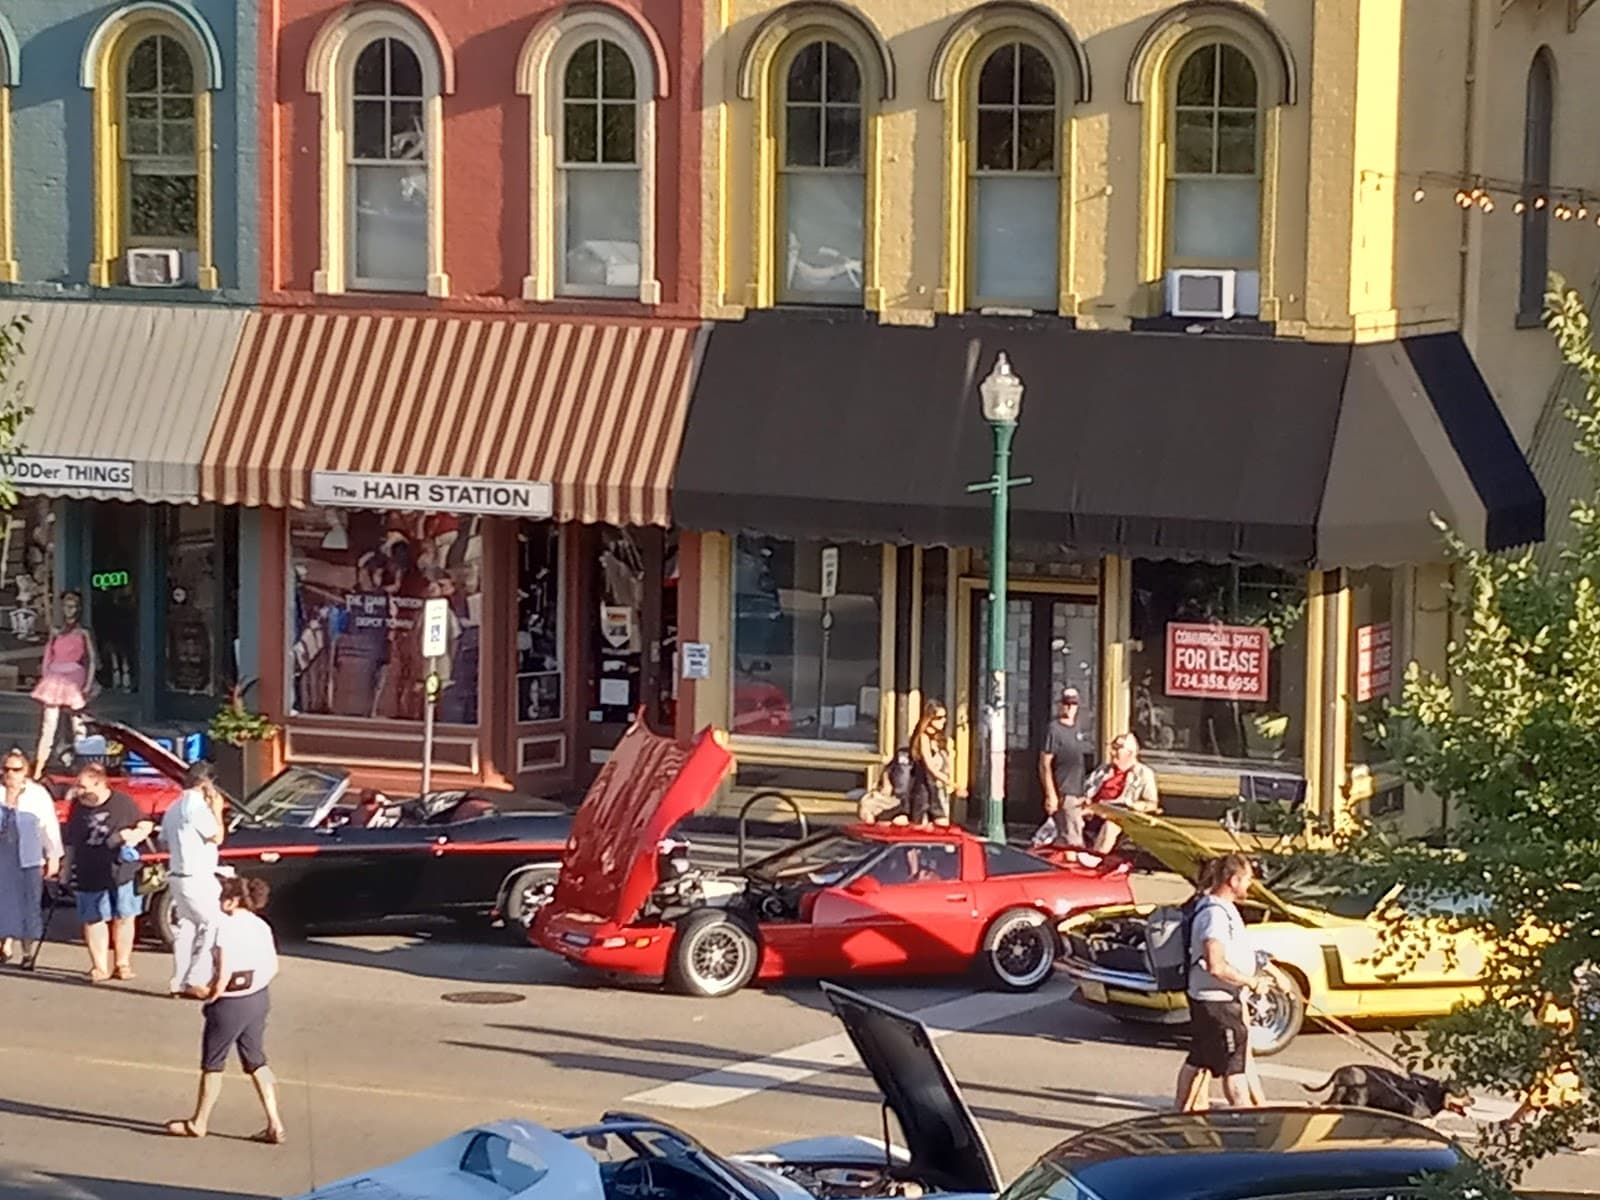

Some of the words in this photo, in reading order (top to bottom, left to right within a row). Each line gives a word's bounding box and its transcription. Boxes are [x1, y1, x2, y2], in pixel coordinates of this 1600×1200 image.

[65, 464, 130, 483] THINGS
[332, 486, 357, 498] The
[363, 481, 420, 502] HAIR
[428, 484, 530, 507] STATION
[1175, 647, 1207, 671] FOR
[1209, 648, 1260, 674] LEASE
